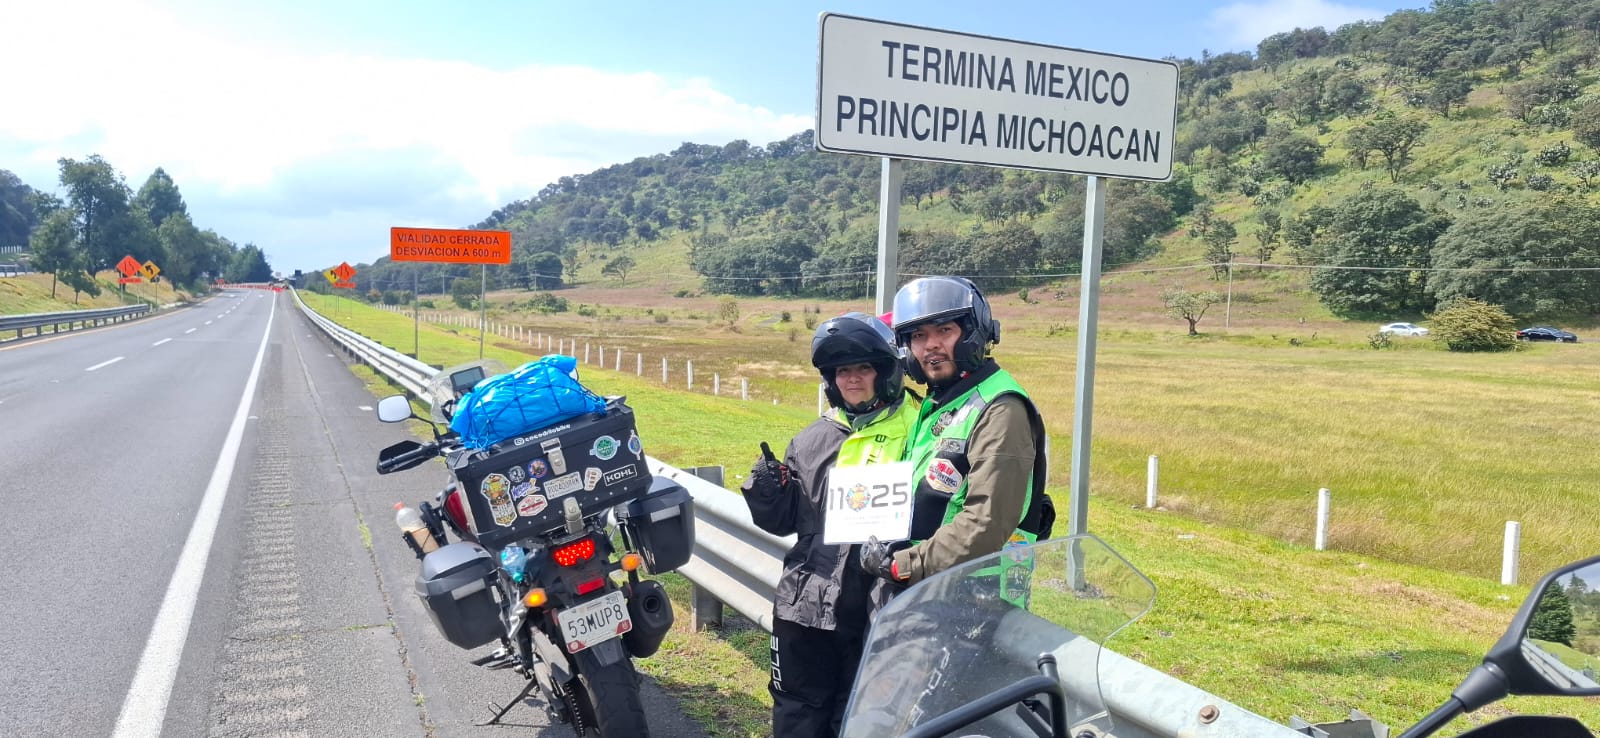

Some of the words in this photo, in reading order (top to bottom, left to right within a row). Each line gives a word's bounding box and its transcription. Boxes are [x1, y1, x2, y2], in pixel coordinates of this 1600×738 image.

[881, 40, 1016, 93] TERMINA
[1025, 60, 1130, 107] MEXICO
[836, 95, 988, 147] PRINCIPIA
[996, 113, 1161, 164] MICHOACAN
[396, 246, 460, 257] DESVIACION
[462, 248, 470, 257] A
[472, 248, 489, 258] 600
[397, 233, 446, 244] VIALIDAD
[449, 235, 500, 246] CERRADA
[606, 468, 634, 483] KOHL
[871, 482, 908, 508] 25
[567, 603, 623, 639] 53MUP8
[770, 635, 786, 693] POLE
